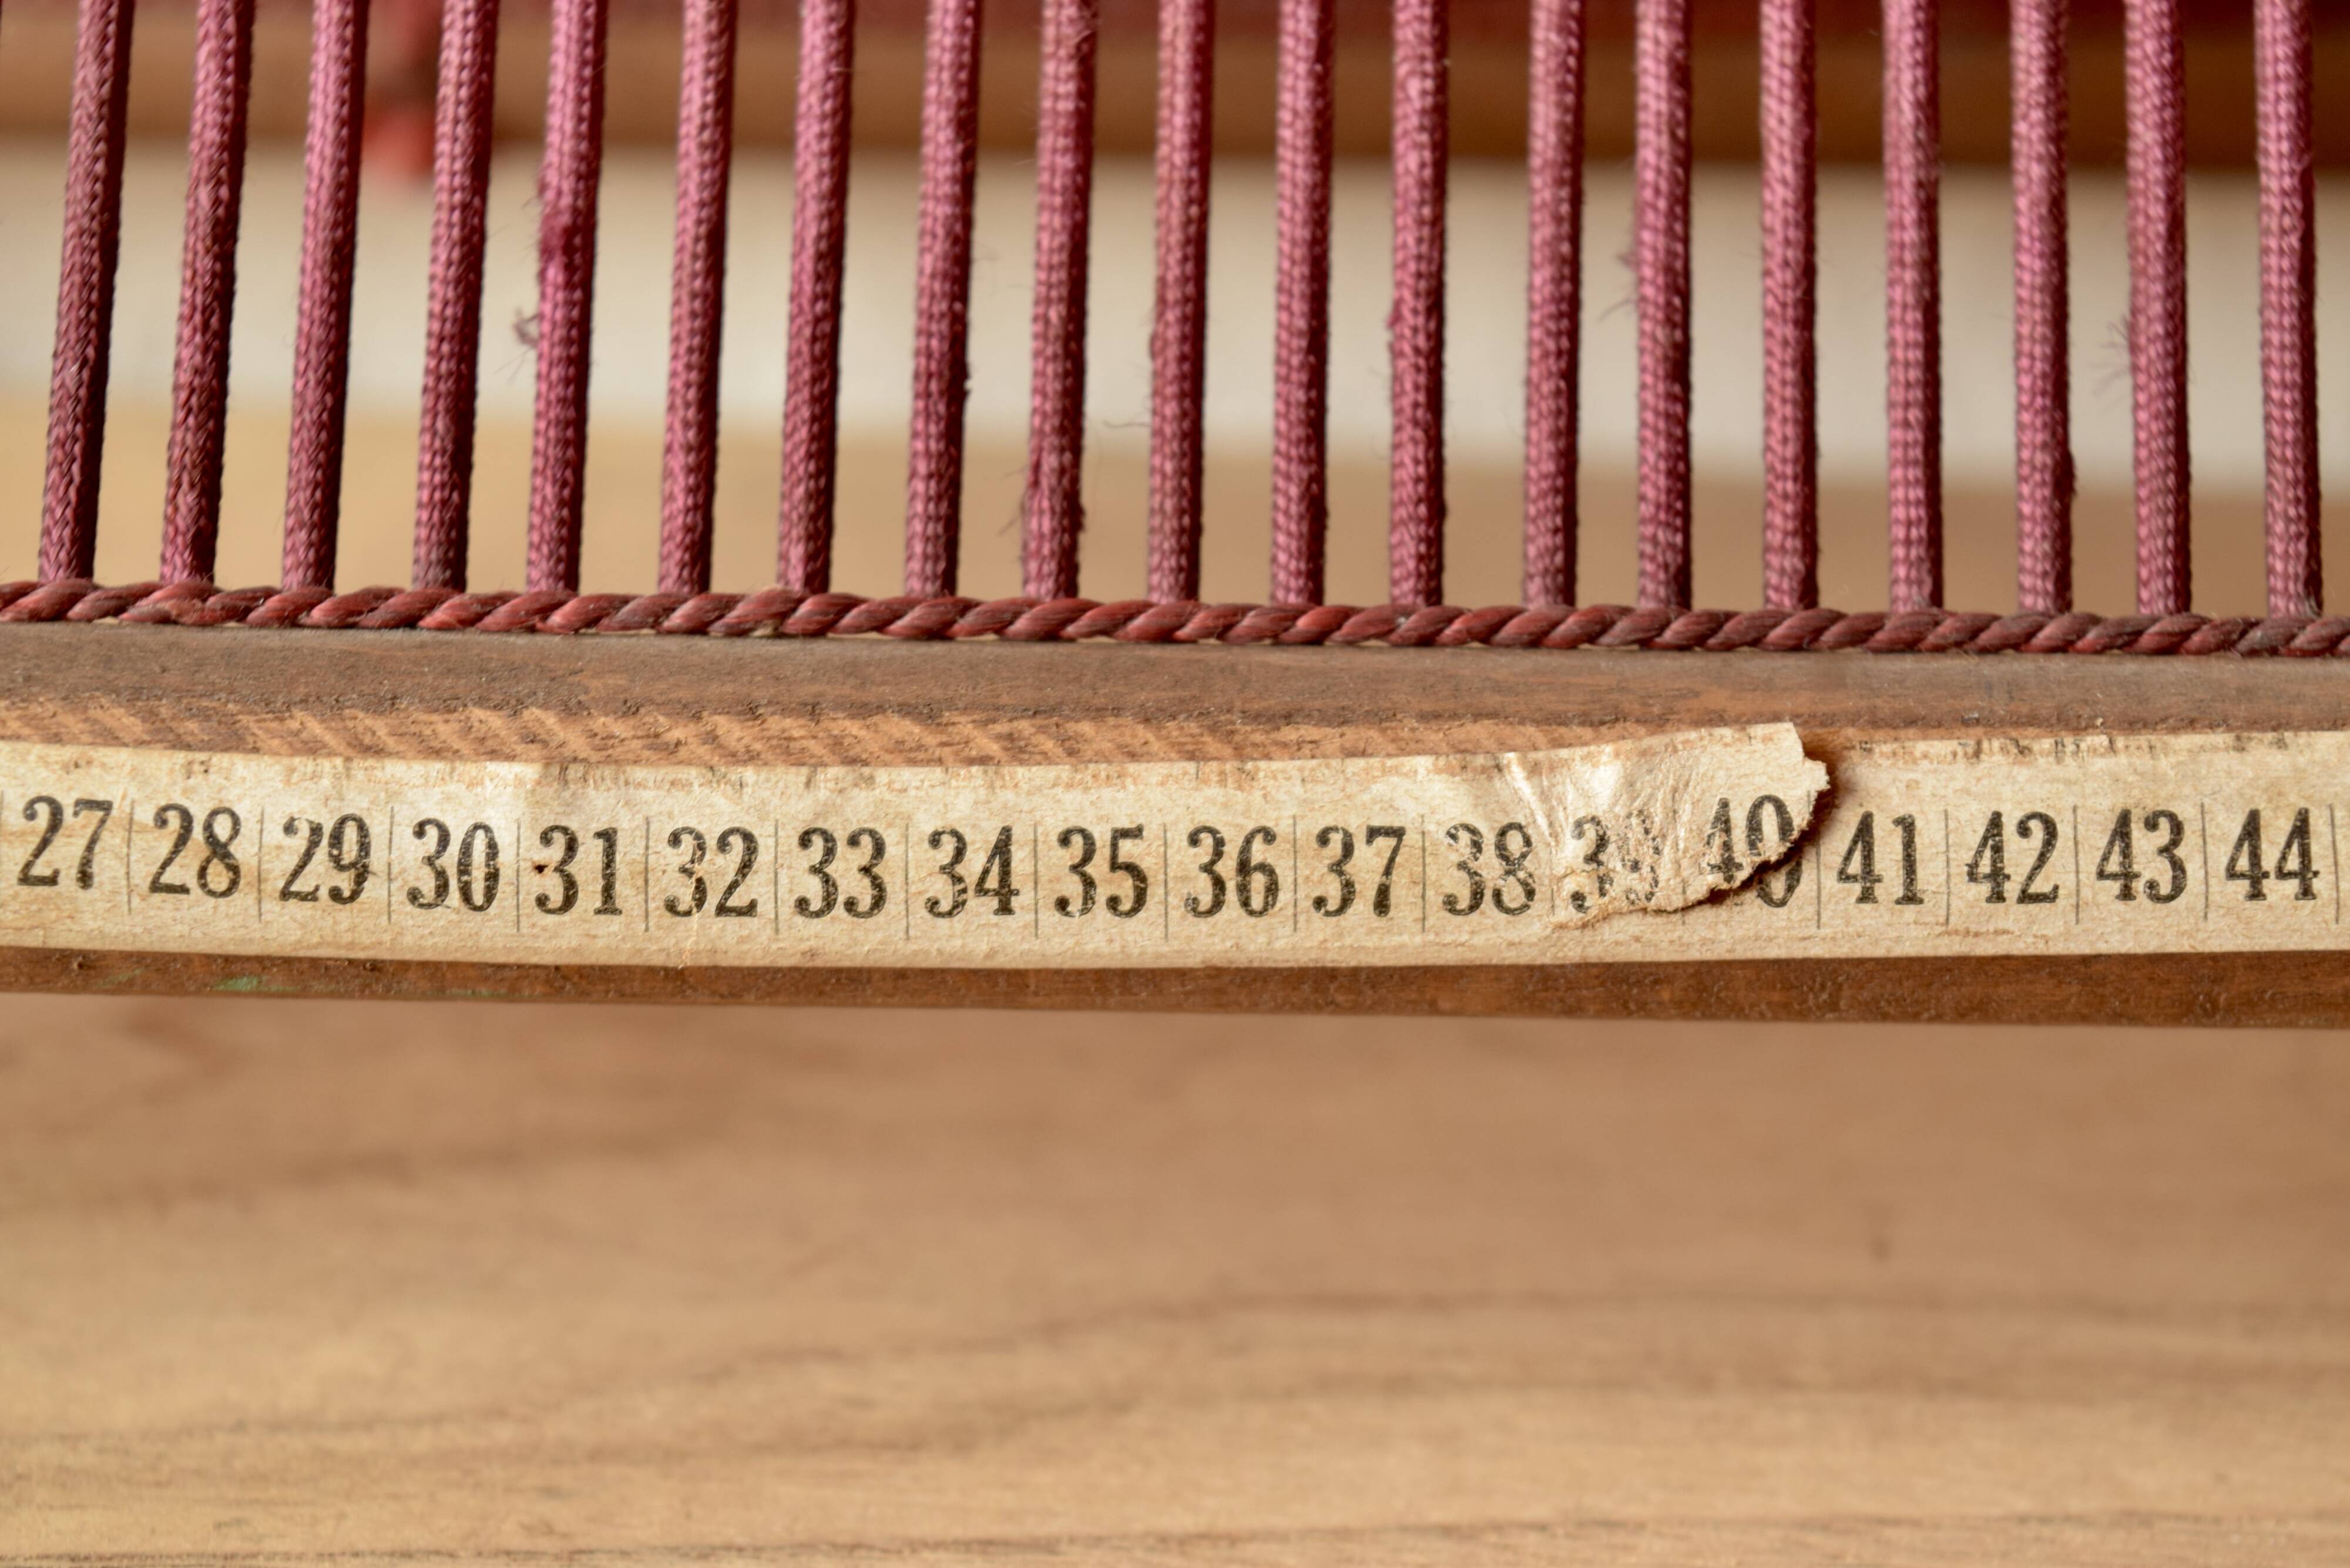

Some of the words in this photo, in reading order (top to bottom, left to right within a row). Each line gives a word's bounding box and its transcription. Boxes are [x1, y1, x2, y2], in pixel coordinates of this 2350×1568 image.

[18, 795, 113, 890] 27
[149, 803, 241, 899] 28
[279, 813, 371, 905] 29
[406, 818, 501, 912] 30
[535, 825, 620, 915] 31
[664, 827, 758, 918] 32
[794, 828, 887, 918] 33
[927, 828, 1020, 918] 34
[1053, 825, 1149, 918] 35
[1187, 825, 1280, 918] 36
[1312, 825, 1406, 918] 37
[1442, 822, 1536, 916] 38
[1705, 794, 1802, 908] 40
[1837, 810, 1925, 905] 41
[1965, 810, 2060, 904] 42
[2096, 808, 2187, 904] 43
[2225, 807, 2320, 901] 44
